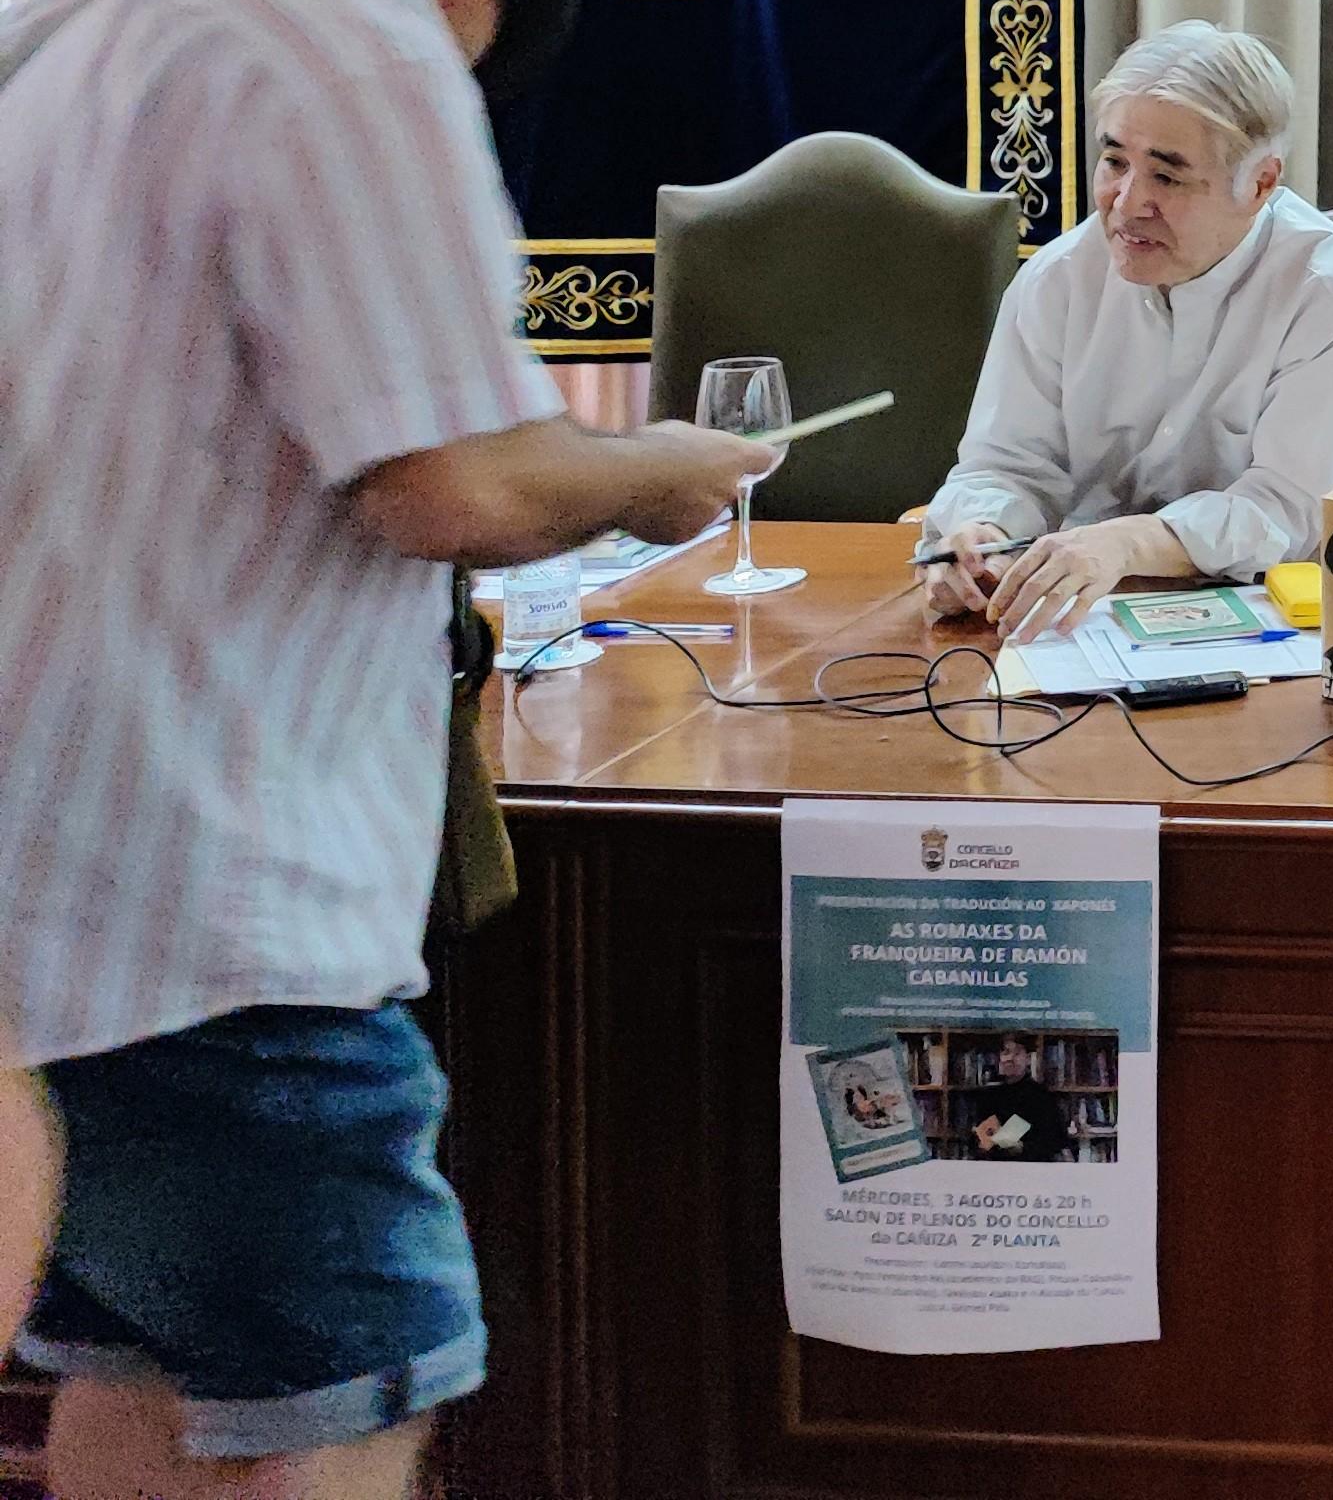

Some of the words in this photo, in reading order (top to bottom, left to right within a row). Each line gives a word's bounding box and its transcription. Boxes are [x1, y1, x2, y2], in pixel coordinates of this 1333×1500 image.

[890, 924, 913, 938] AS
[921, 924, 1013, 940] ROMAXES
[1020, 926, 1046, 940] DA
[850, 945, 976, 963] FRANQUEIRA
[982, 948, 1005, 963] DE
[1012, 947, 1086, 964] RAMÓN
[908, 970, 1028, 986] CABANILLAS
[945, 1194, 953, 1207] 3
[959, 1195, 1027, 1208] AGOSTO
[1057, 1195, 1076, 1208] 20
[886, 1212, 905, 1225] DE
[912, 1213, 977, 1227] PLENOS
[987, 1214, 1011, 1228] DO
[1017, 1214, 1110, 1228] CONCELLO
[993, 1234, 1060, 1247] PLANTA
